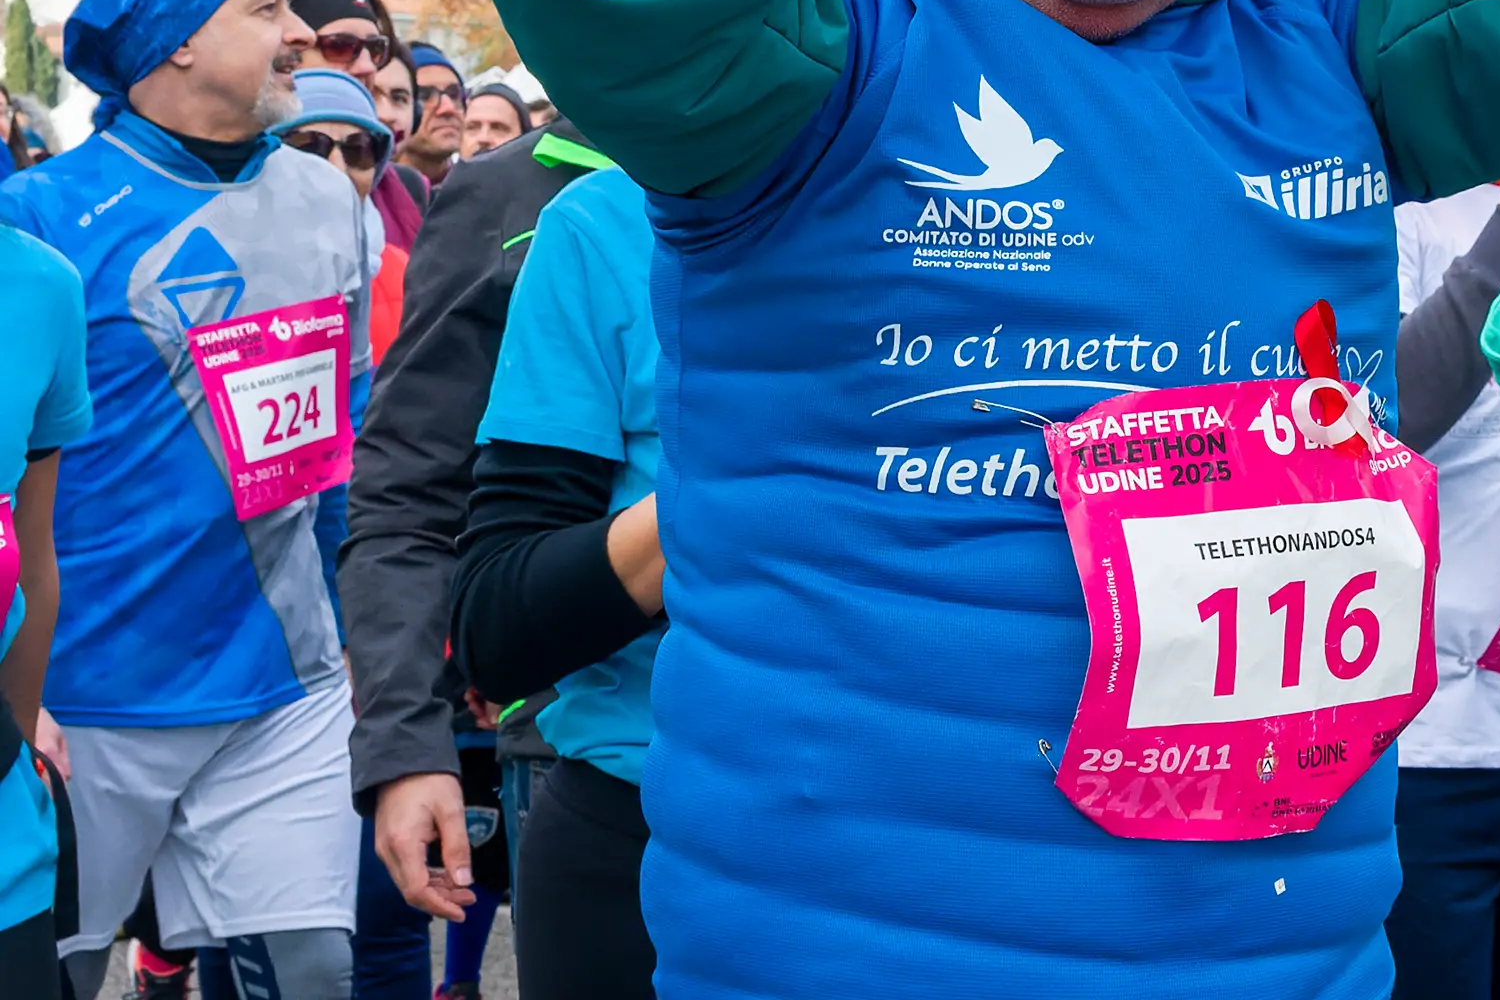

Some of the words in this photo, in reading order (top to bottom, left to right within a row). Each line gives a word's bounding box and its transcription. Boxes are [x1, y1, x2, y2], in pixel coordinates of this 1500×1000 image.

[1280, 156, 1343, 180] GRUPPO
[1280, 162, 1388, 220] illiria
[882, 229, 973, 247] COMITATO
[978, 232, 996, 247] DI
[1002, 232, 1057, 248] UDINE
[1061, 231, 1095, 247] odv
[913, 247, 990, 260] Associazione
[992, 249, 1052, 261] Nazionale
[912, 258, 951, 269] Donne
[955, 261, 1006, 272] Operate
[1007, 261, 1019, 272] al
[1021, 262, 1051, 273] Seno
[196, 322, 261, 346] STAFFETTA
[875, 322, 934, 368] Io
[953, 324, 1003, 369] ci
[1021, 333, 1179, 373] metto
[1199, 320, 1241, 376] il
[202, 350, 241, 369] UDINE
[257, 385, 321, 446] 224
[1066, 405, 1225, 447] STAFFETTA
[1071, 431, 1227, 469] TELETHON
[1368, 451, 1412, 476] group
[875, 446, 1060, 500] Teleth
[1077, 466, 1164, 495] UDINE
[1169, 460, 1232, 487] 2025
[1194, 527, 1376, 561] TELETHONANDOS4
[1101, 556, 1123, 694] www.telethonudine.it
[1197, 570, 1381, 697] 116
[1078, 743, 1232, 775] 29-30/11
[1297, 739, 1348, 769] UDINE
[1076, 774, 1224, 821] 24X1
